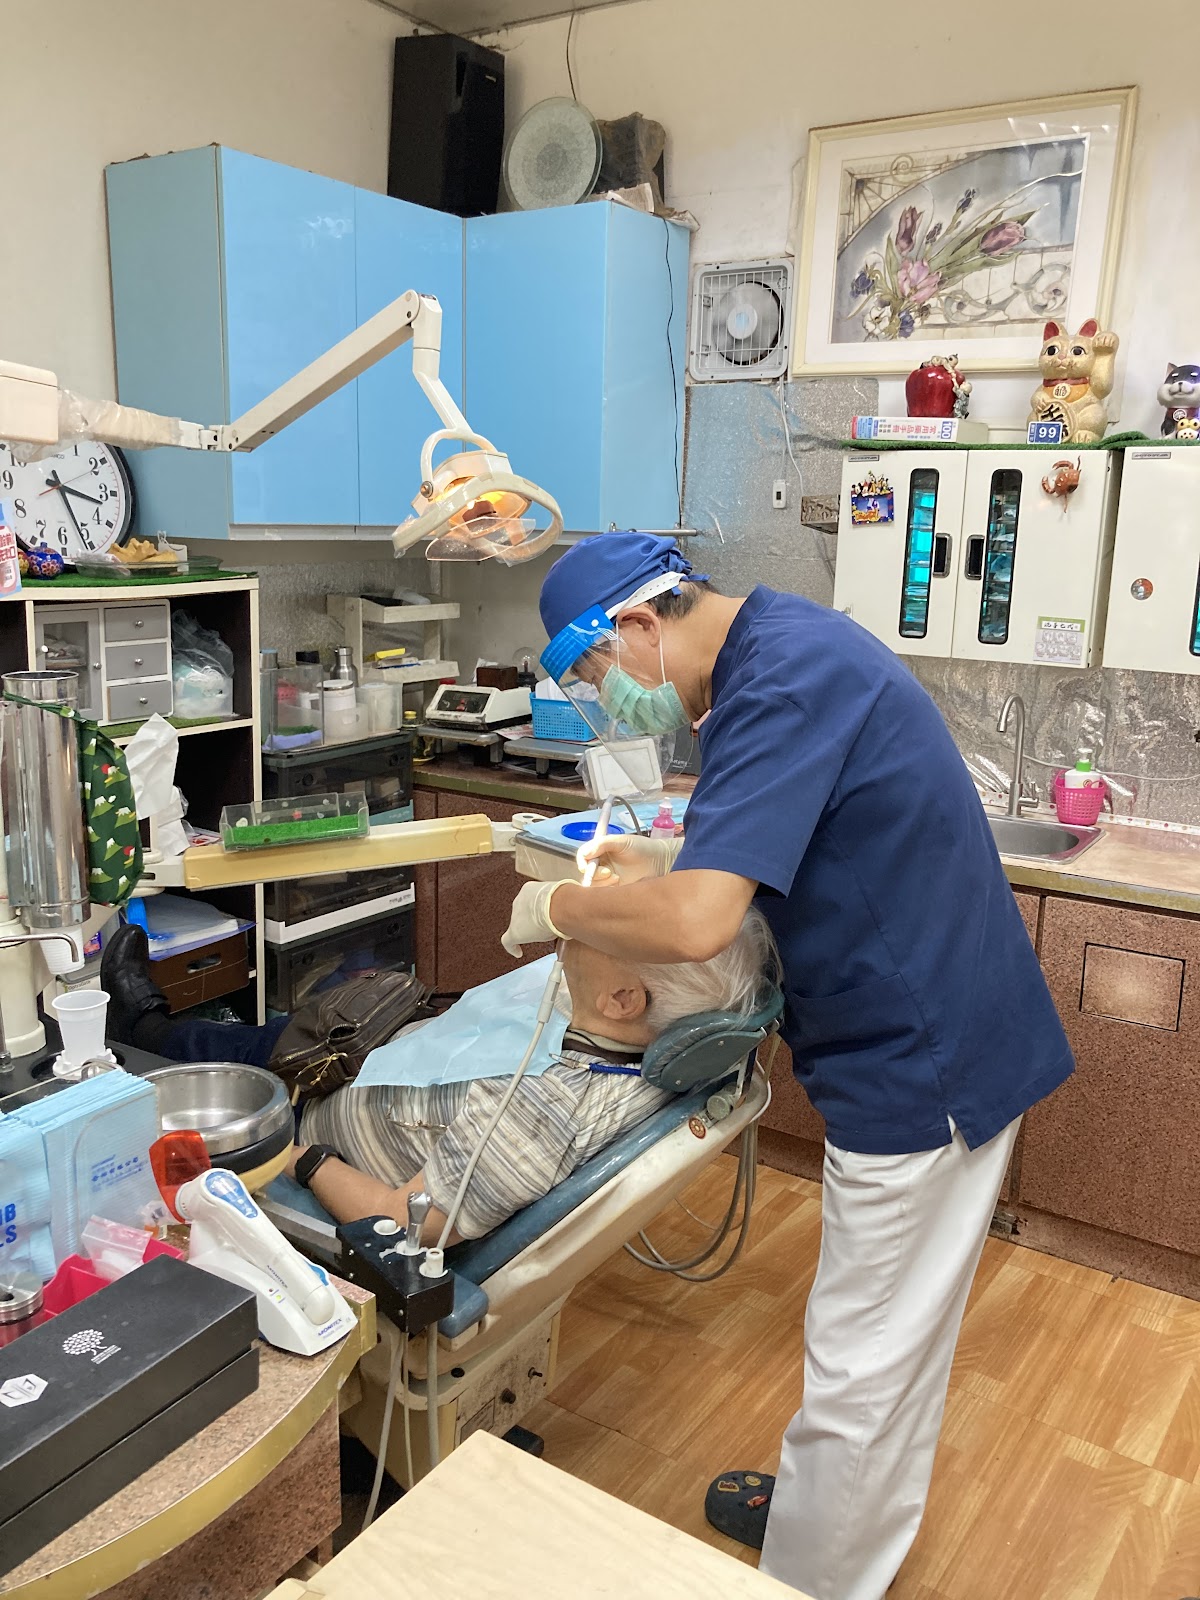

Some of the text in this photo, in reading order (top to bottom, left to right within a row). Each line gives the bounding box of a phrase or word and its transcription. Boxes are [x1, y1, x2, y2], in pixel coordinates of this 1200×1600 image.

[941, 421, 953, 439] 100
[1038, 426, 1057, 439] 99
[88, 457, 100, 476] 2
[2, 470, 14, 490] 9
[98, 483, 109, 501] 3
[14, 498, 27, 518] 8
[92, 507, 102, 525] 4
[36, 519, 47, 538] 7
[57, 526, 68, 546] 6
[80, 522, 90, 541] 5
[0, 1203, 16, 1226] B
[0, 1224, 17, 1248] S
